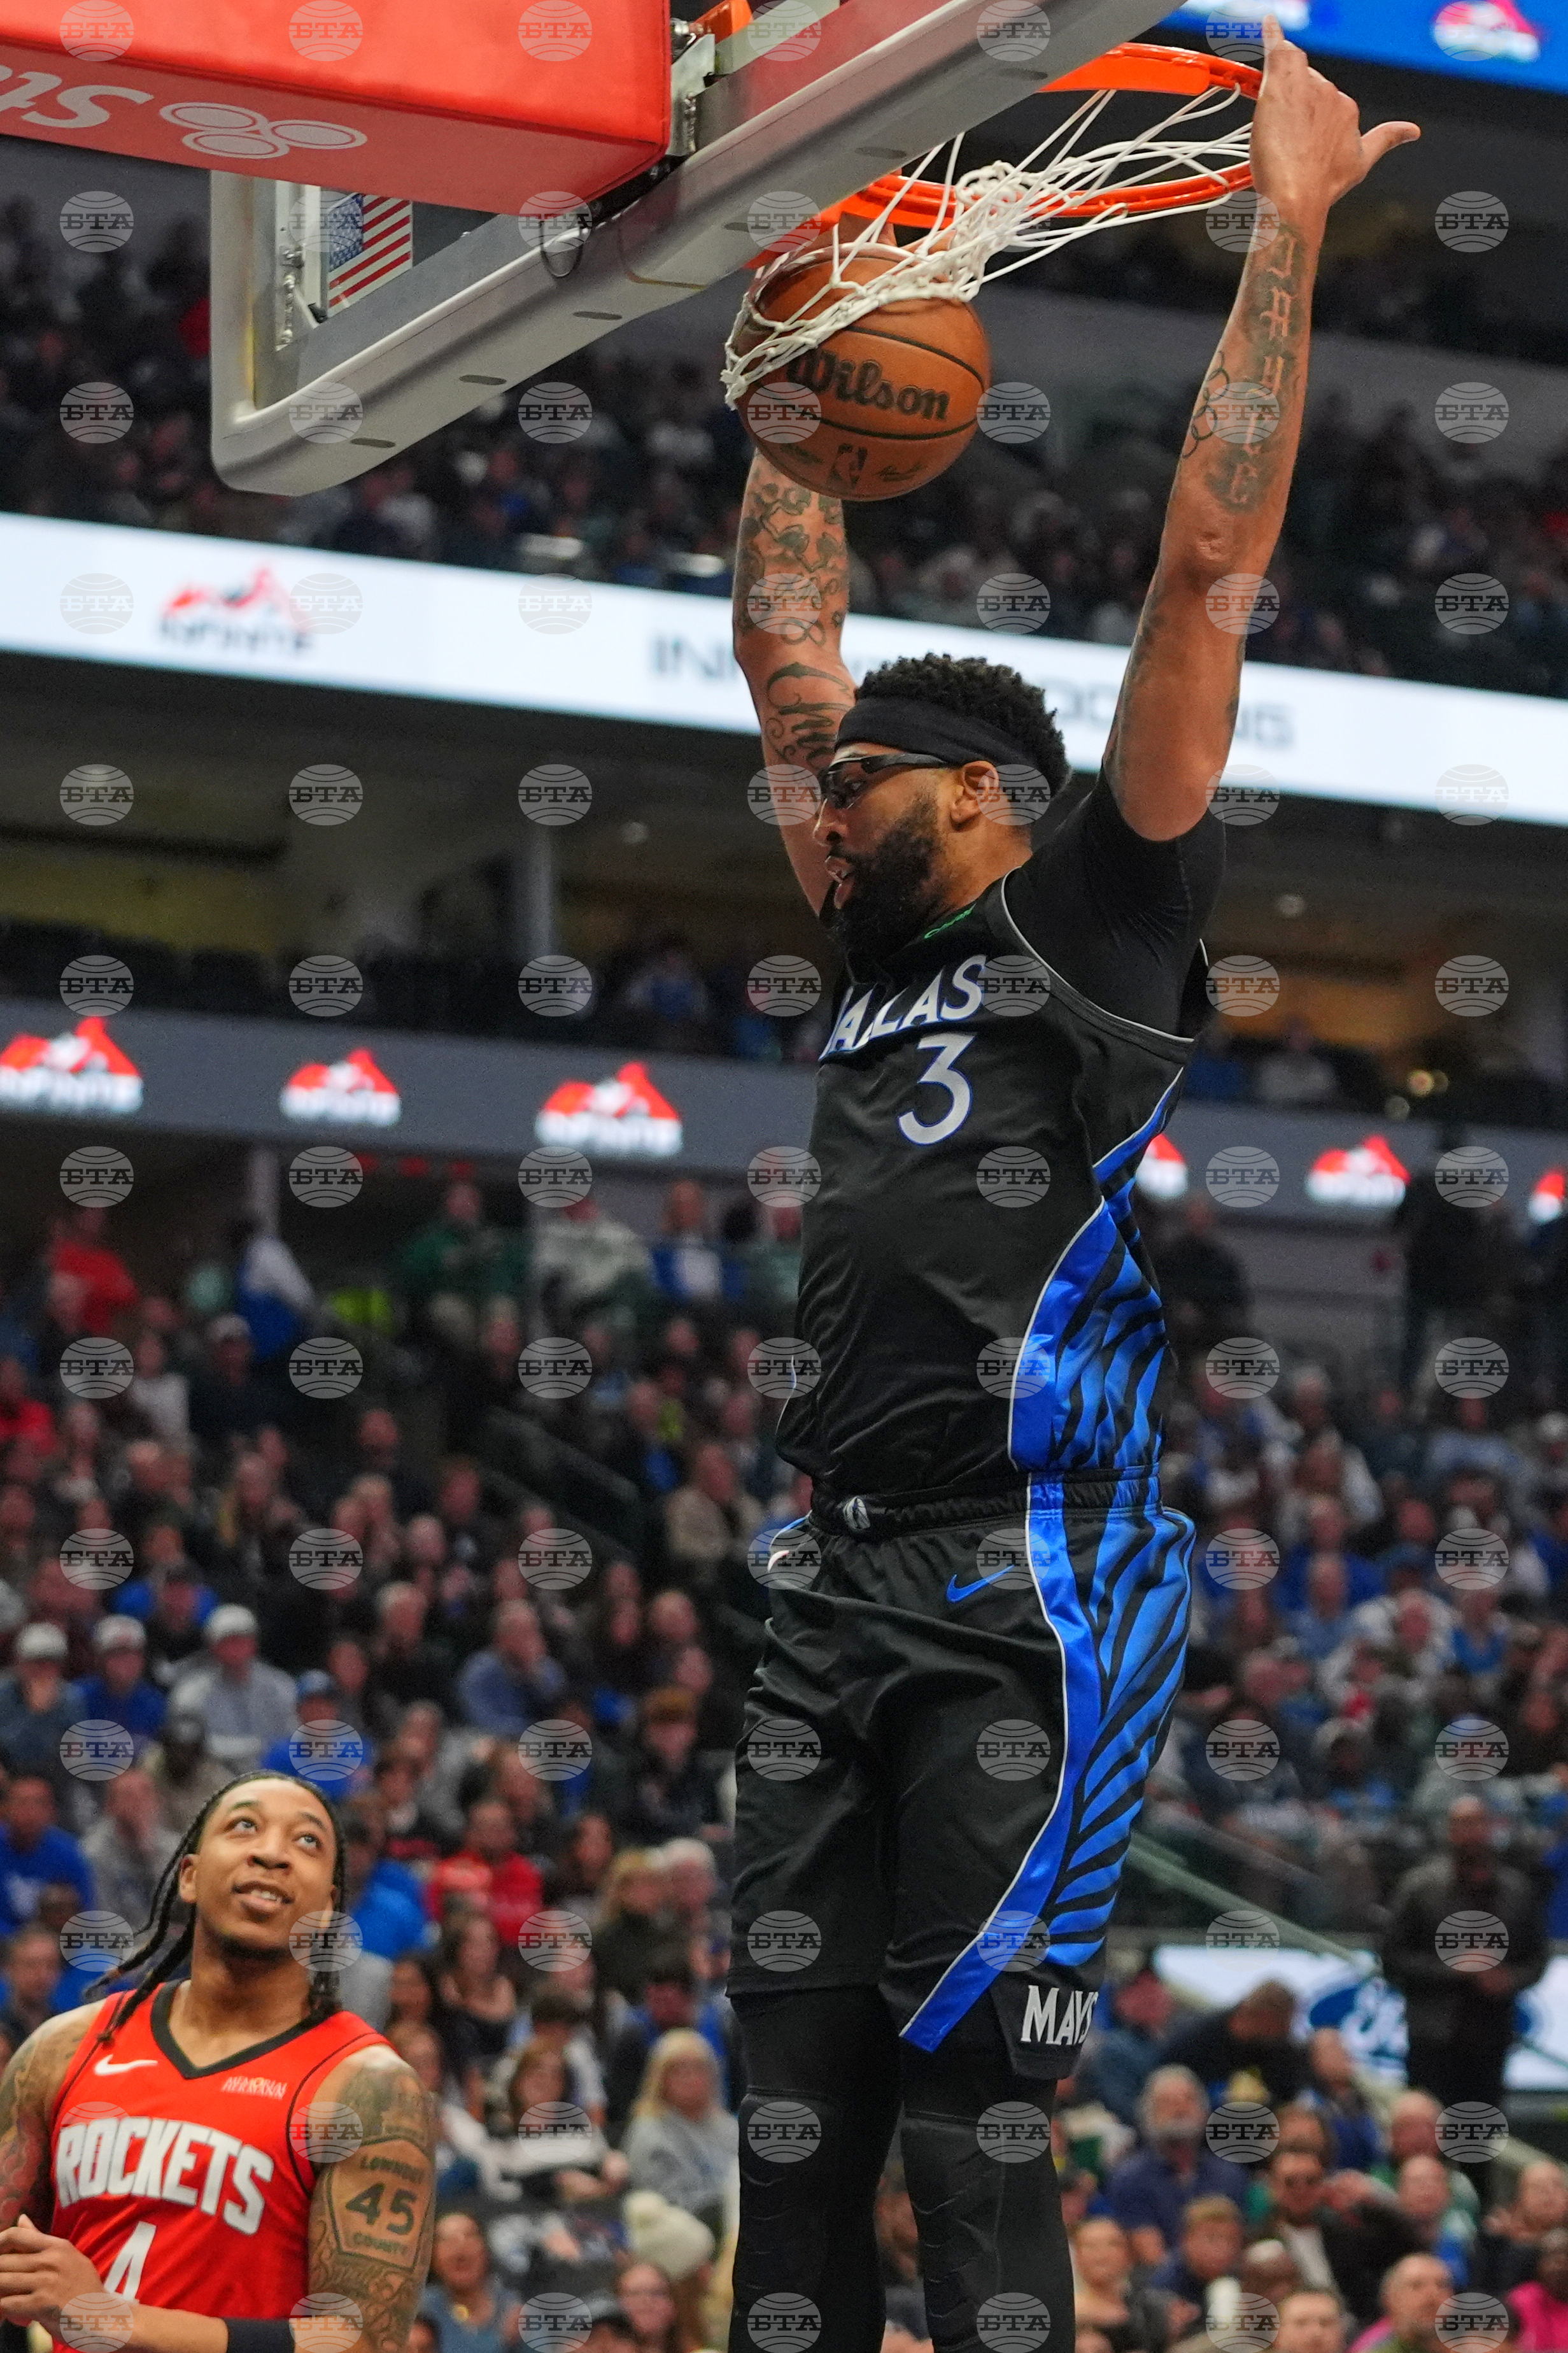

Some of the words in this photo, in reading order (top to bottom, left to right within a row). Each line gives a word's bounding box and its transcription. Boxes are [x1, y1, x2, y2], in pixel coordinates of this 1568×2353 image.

[786, 350, 950, 420] Wilson
[898, 1032, 977, 1145] 3
[1021, 1984, 1099, 2045] MAVS
[56, 2115, 274, 2236] ROCKETS
[345, 2182, 418, 2235] 45
[103, 2221, 157, 2304] 4
